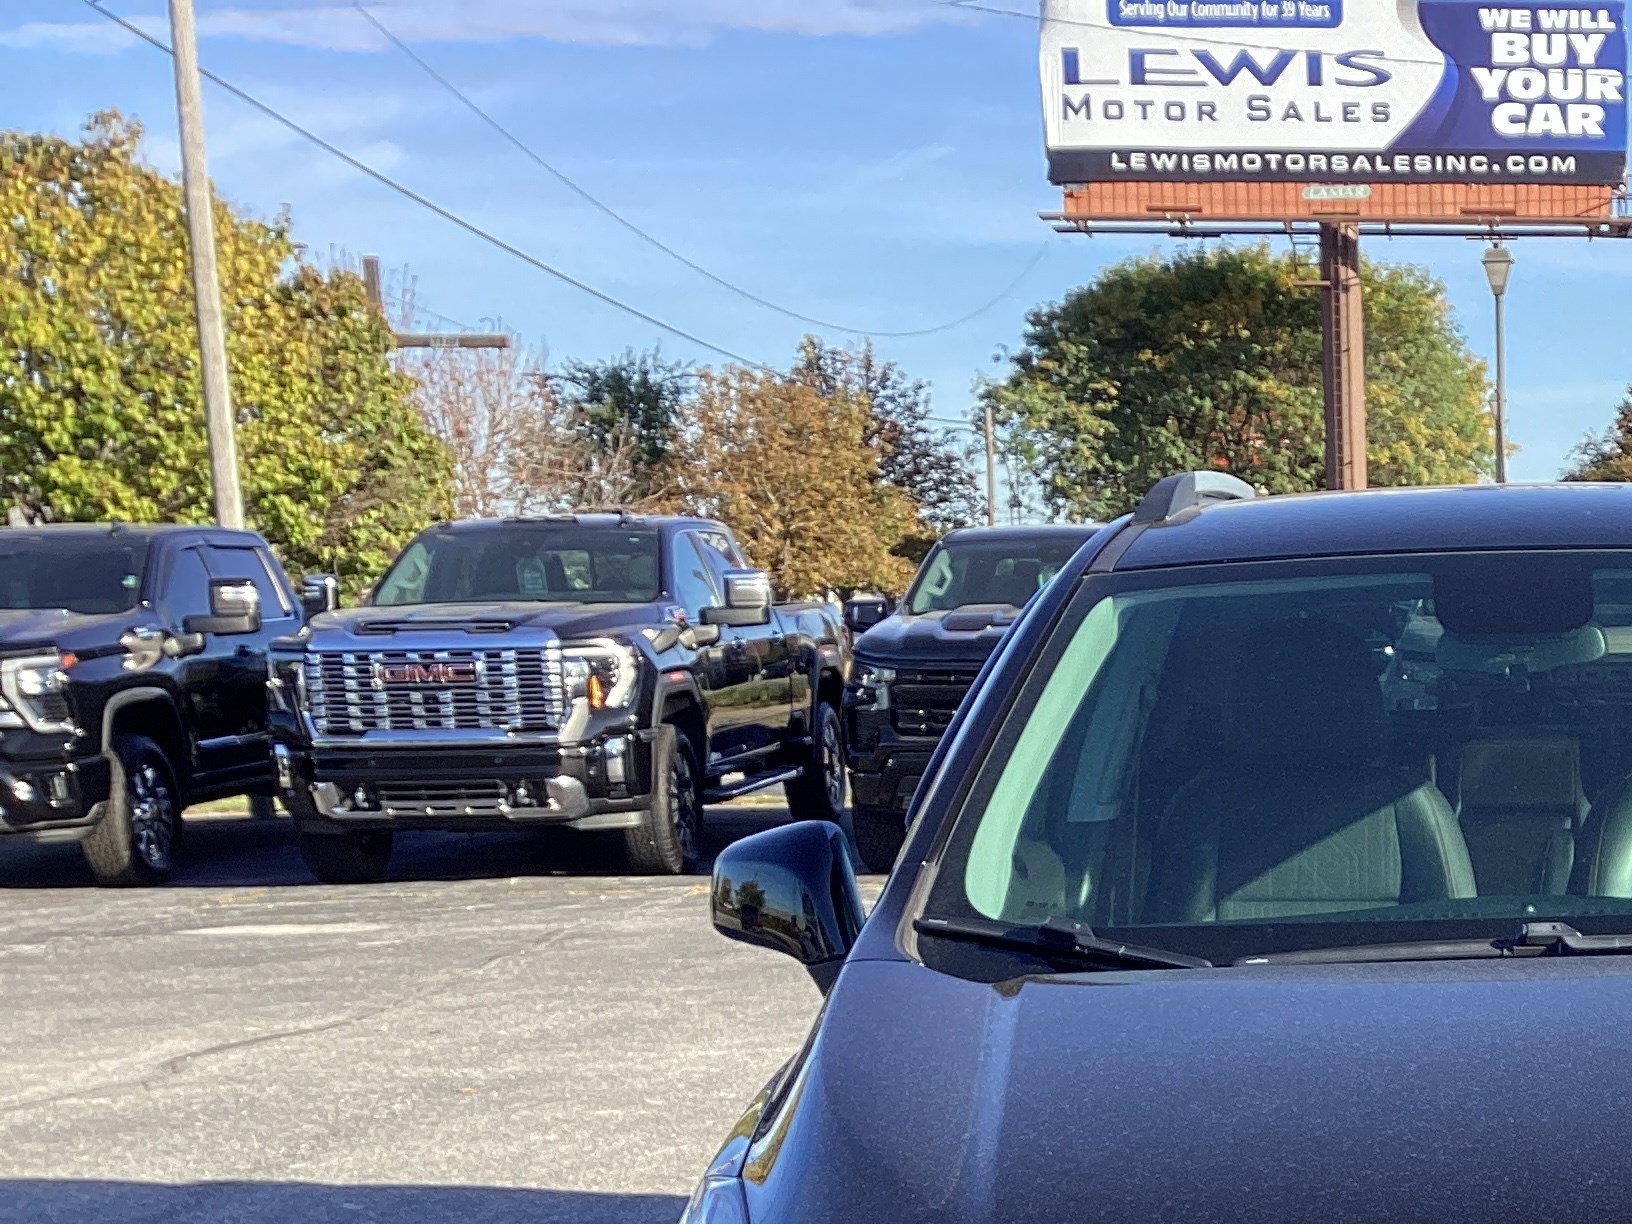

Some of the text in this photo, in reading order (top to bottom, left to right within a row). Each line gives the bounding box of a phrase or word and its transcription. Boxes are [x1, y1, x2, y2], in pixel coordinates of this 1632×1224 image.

[1120, 0, 1331, 19] Serving Our Community for 39 Years
[1478, 8, 1616, 31] WE WILL
[1492, 32, 1606, 66] BUY
[1061, 47, 1392, 87] LEWIS
[1471, 67, 1624, 102] YOUR
[1062, 93, 1391, 123] MOTOR SALES
[1492, 102, 1606, 137] CAR
[1111, 152, 1576, 174] LEWISMOTORSALESINC.COM
[382, 663, 477, 683] GMC
